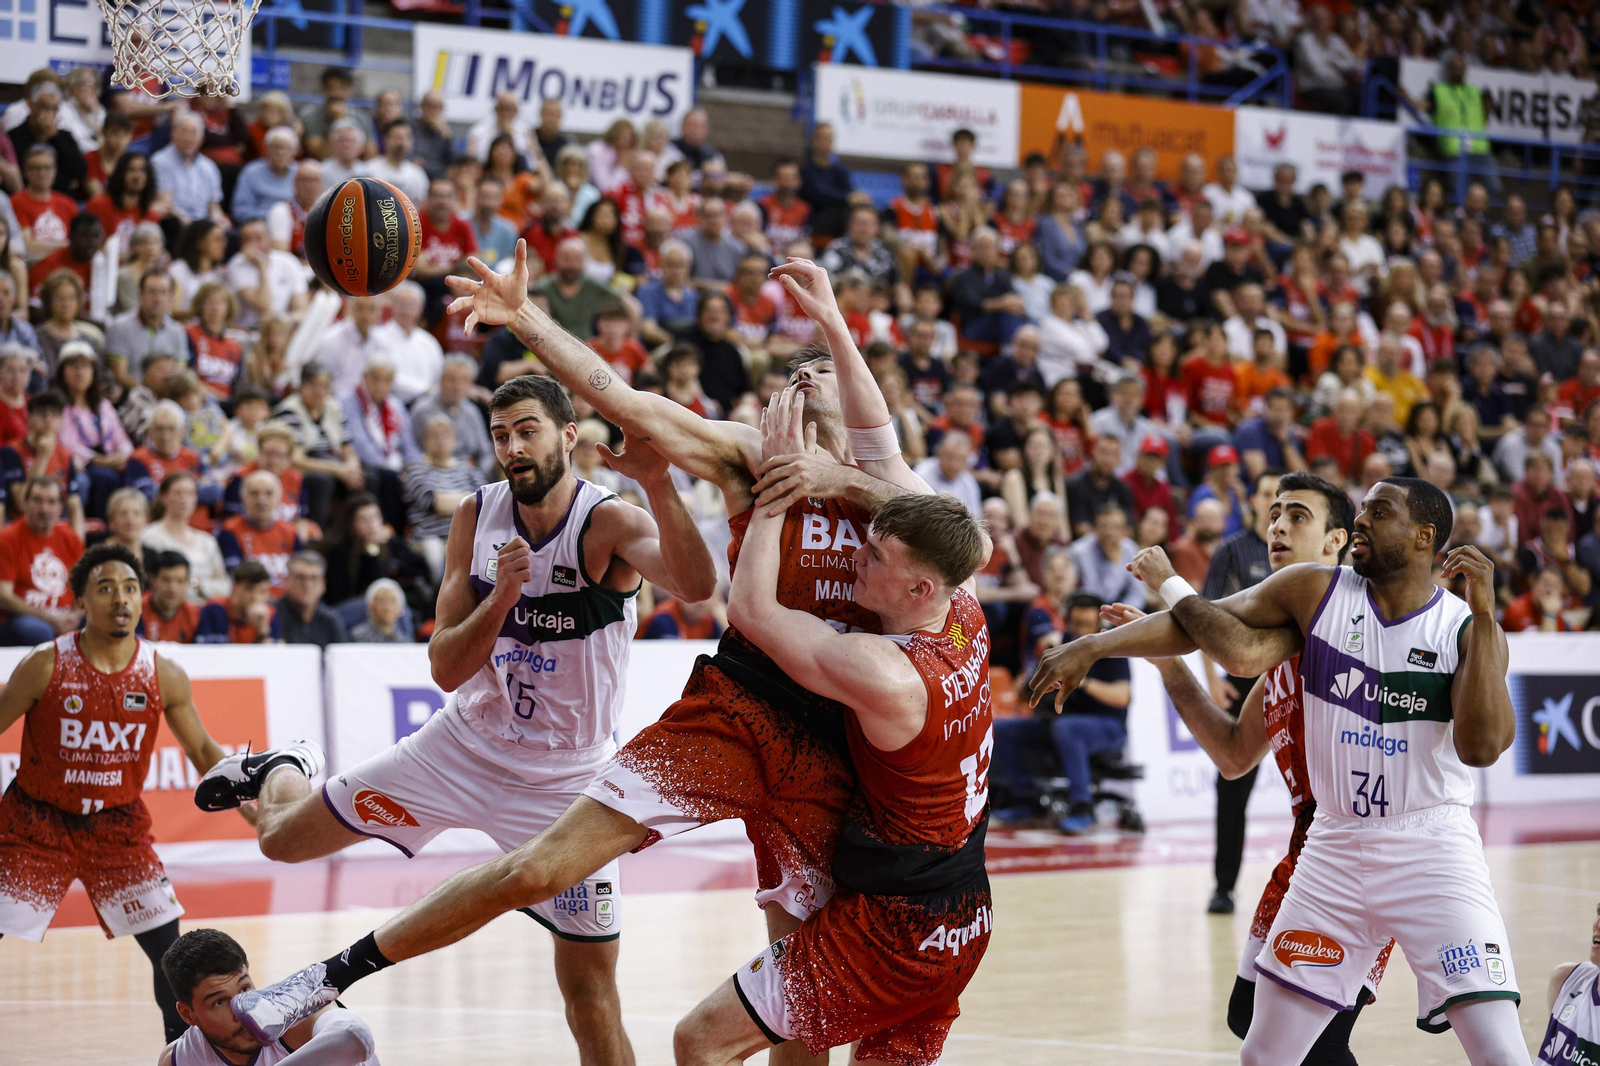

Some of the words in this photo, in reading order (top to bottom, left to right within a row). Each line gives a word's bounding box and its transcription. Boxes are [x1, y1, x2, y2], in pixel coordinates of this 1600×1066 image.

[1482, 85, 1592, 131] NRES
[339, 196, 356, 256] endesa
[377, 196, 399, 280] SPALDING
[345, 258, 359, 282] liga
[801, 513, 863, 552] BA
[1263, 660, 1295, 712] AXI
[60, 718, 147, 751] BAXI
[60, 749, 141, 765] CLIMATIZACIÓN
[64, 769, 122, 786] MANRESA
[1351, 770, 1389, 818] 34
[597, 886, 611, 894] acb
[123, 900, 145, 915] ETL
[553, 896, 590, 917] laga
[794, 891, 820, 913] GLO
[127, 906, 167, 926] GLOBAL
[1274, 931, 1341, 960] famadesa
[1486, 945, 1498, 953] acb
[1441, 957, 1482, 977] laga
